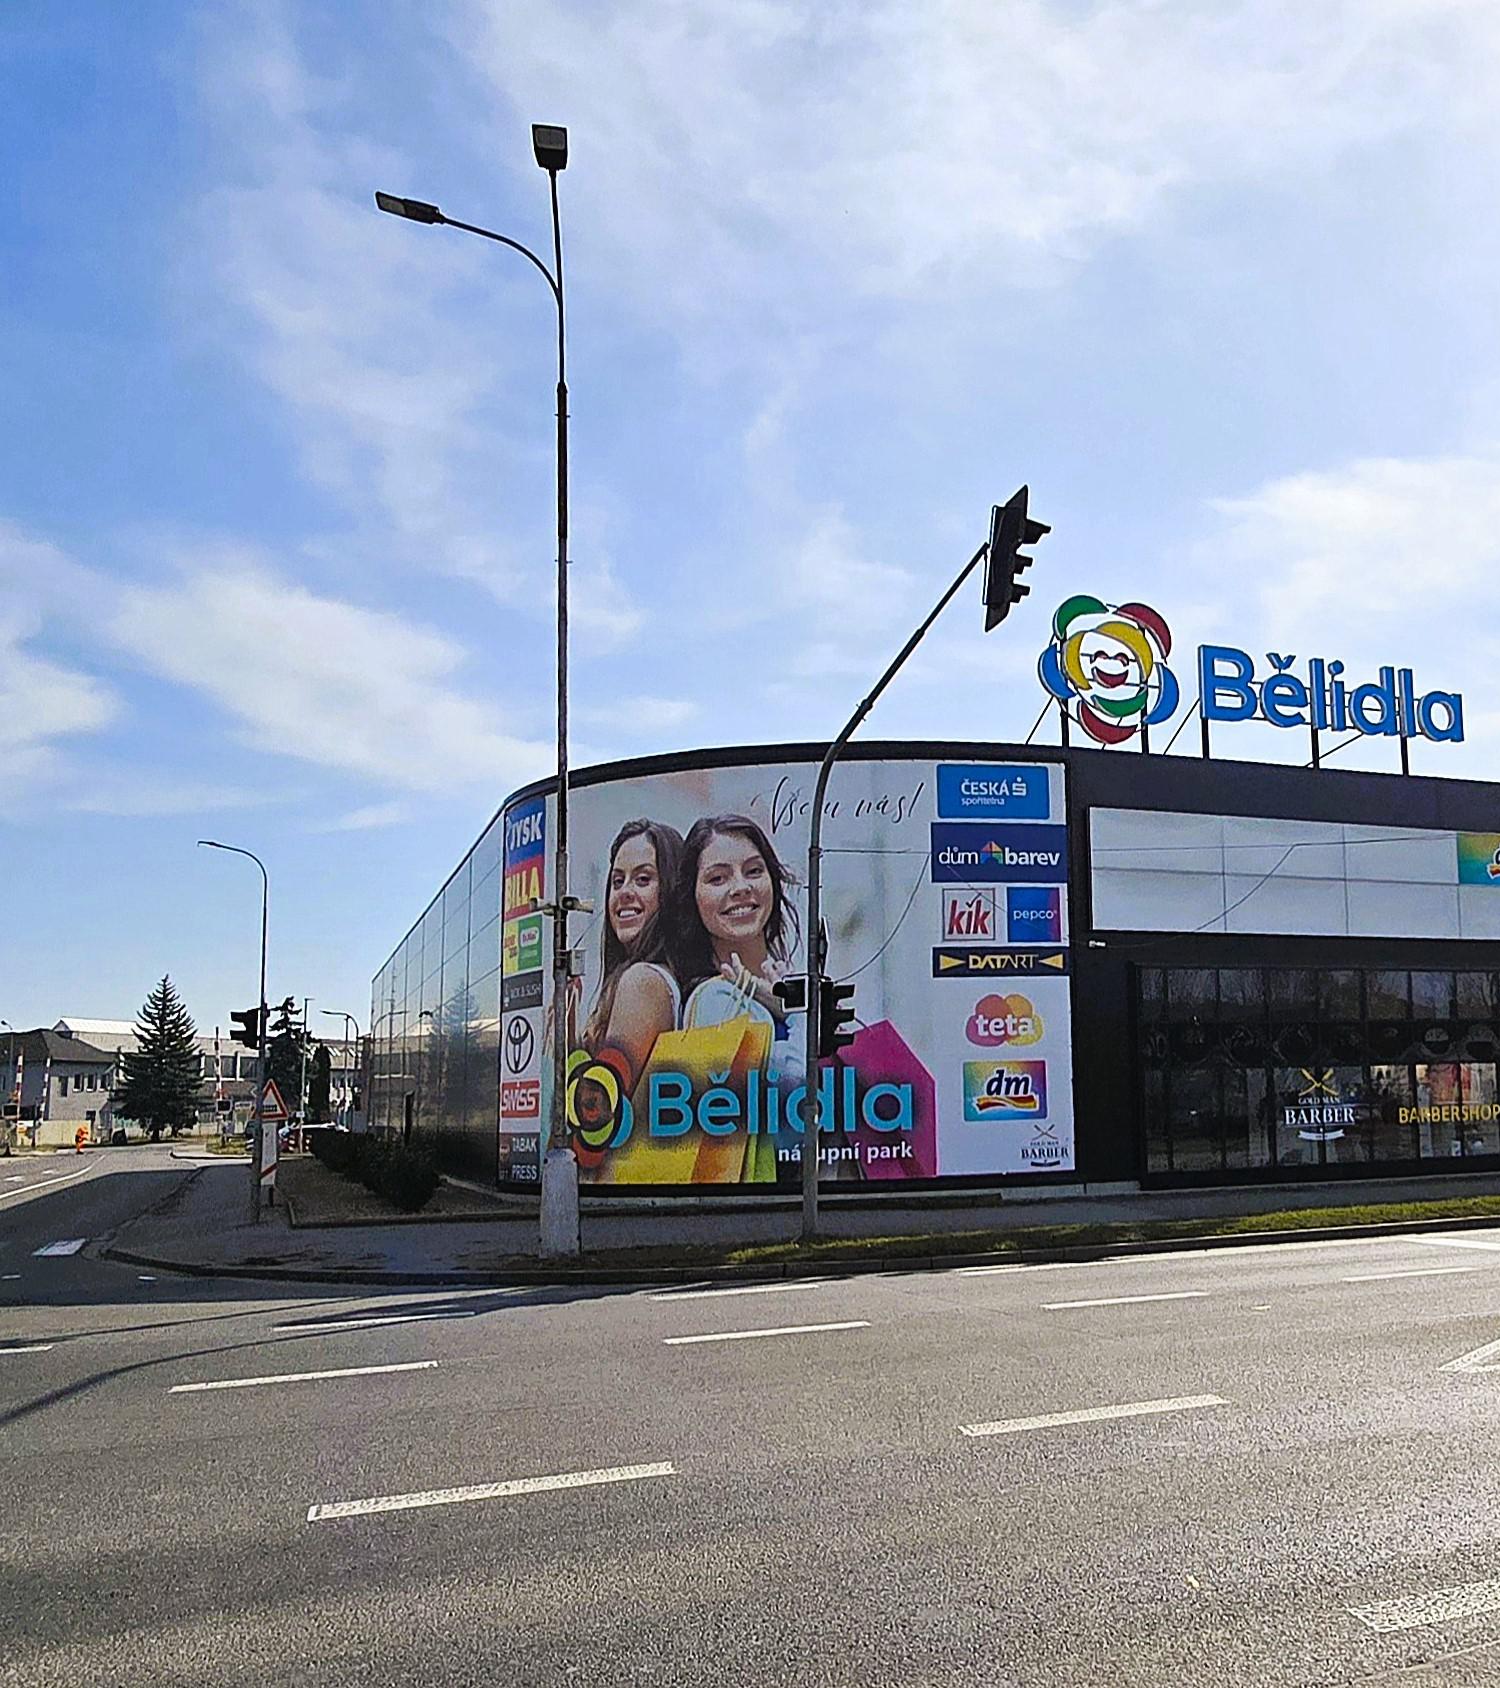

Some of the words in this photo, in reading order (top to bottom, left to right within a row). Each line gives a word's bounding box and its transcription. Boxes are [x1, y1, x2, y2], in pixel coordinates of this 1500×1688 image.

[1198, 644, 1464, 742] Bělidla
[961, 778, 1010, 796] ČESKÁ
[510, 811, 543, 851] JYSK
[939, 847, 978, 865] dům
[1005, 848, 1060, 865] barev
[948, 893, 990, 935] kik
[1013, 909, 1054, 920] pepco
[968, 954, 1039, 969] DATART
[976, 1014, 1034, 1037] teta
[986, 1069, 1030, 1096] dm
[649, 1066, 914, 1137] Bělidla
[1285, 1107, 1355, 1125] BARBER
[1399, 1103, 1500, 1124] BARBERSHOP
[512, 1138, 537, 1153] TABAK
[778, 1142, 859, 1164] náupní
[867, 1141, 913, 1163] park
[512, 1165, 538, 1180] PRESS
